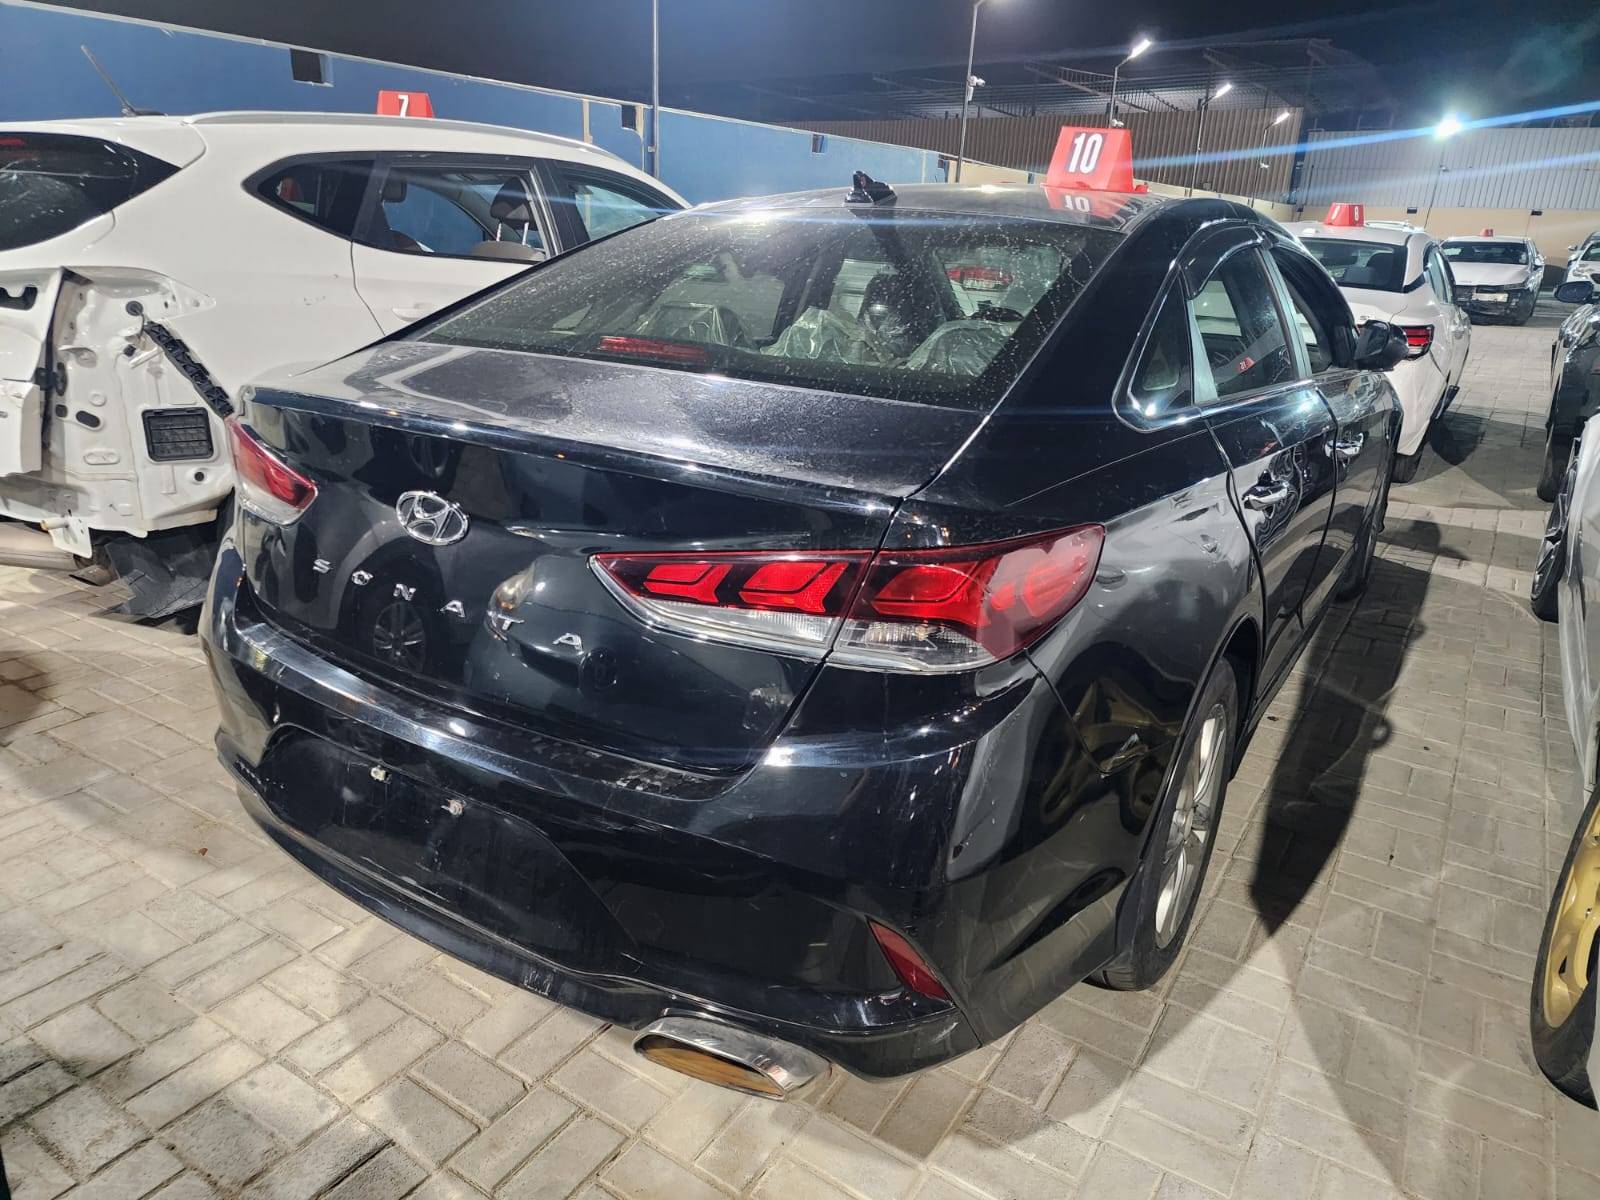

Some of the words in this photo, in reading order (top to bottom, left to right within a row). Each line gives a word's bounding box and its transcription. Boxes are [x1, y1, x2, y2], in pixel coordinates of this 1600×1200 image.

[398, 94, 409, 118] 7
[1068, 132, 1103, 174] 10
[313, 559, 583, 650] SONATA
